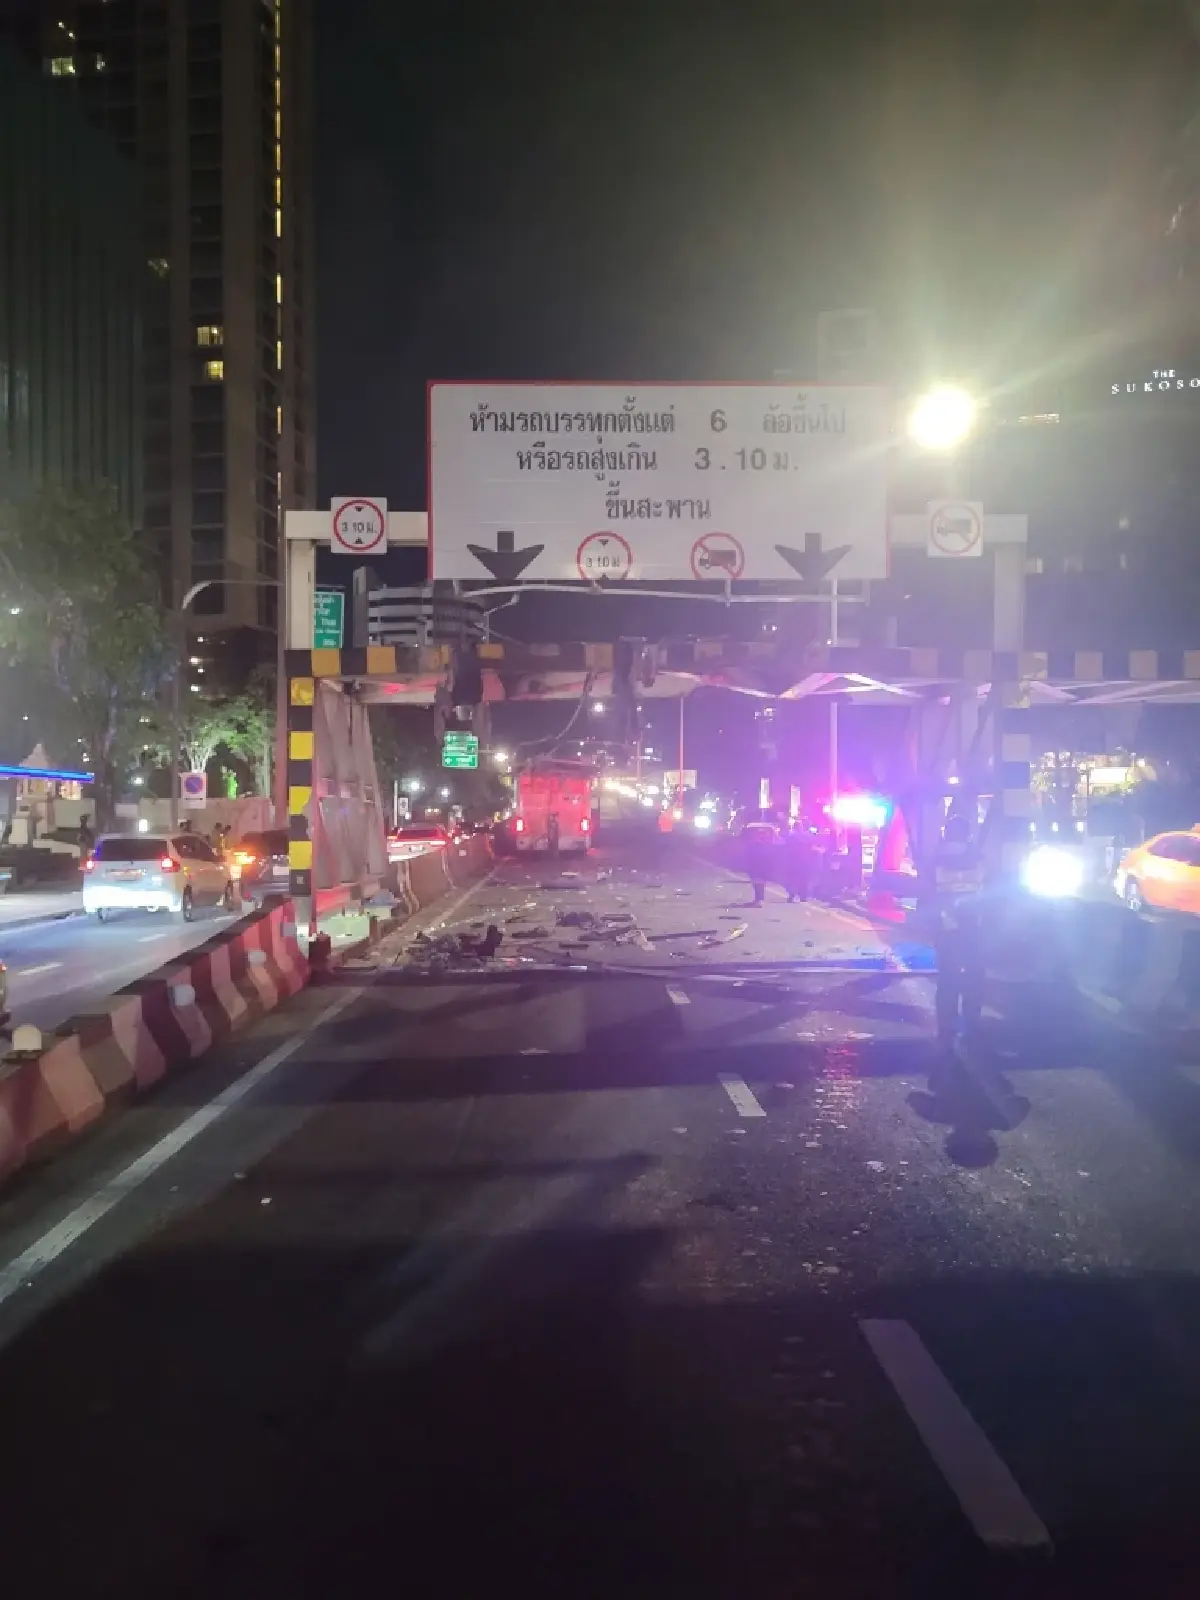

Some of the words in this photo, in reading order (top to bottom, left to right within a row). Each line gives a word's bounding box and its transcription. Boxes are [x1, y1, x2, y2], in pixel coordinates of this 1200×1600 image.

[1153, 369, 1175, 378] THE
[469, 396, 675, 444] ห้ามรถบรรทุกตั้งแต่
[710, 409, 728, 433] 6
[516, 441, 658, 481] หรือรถสูงเกิน
